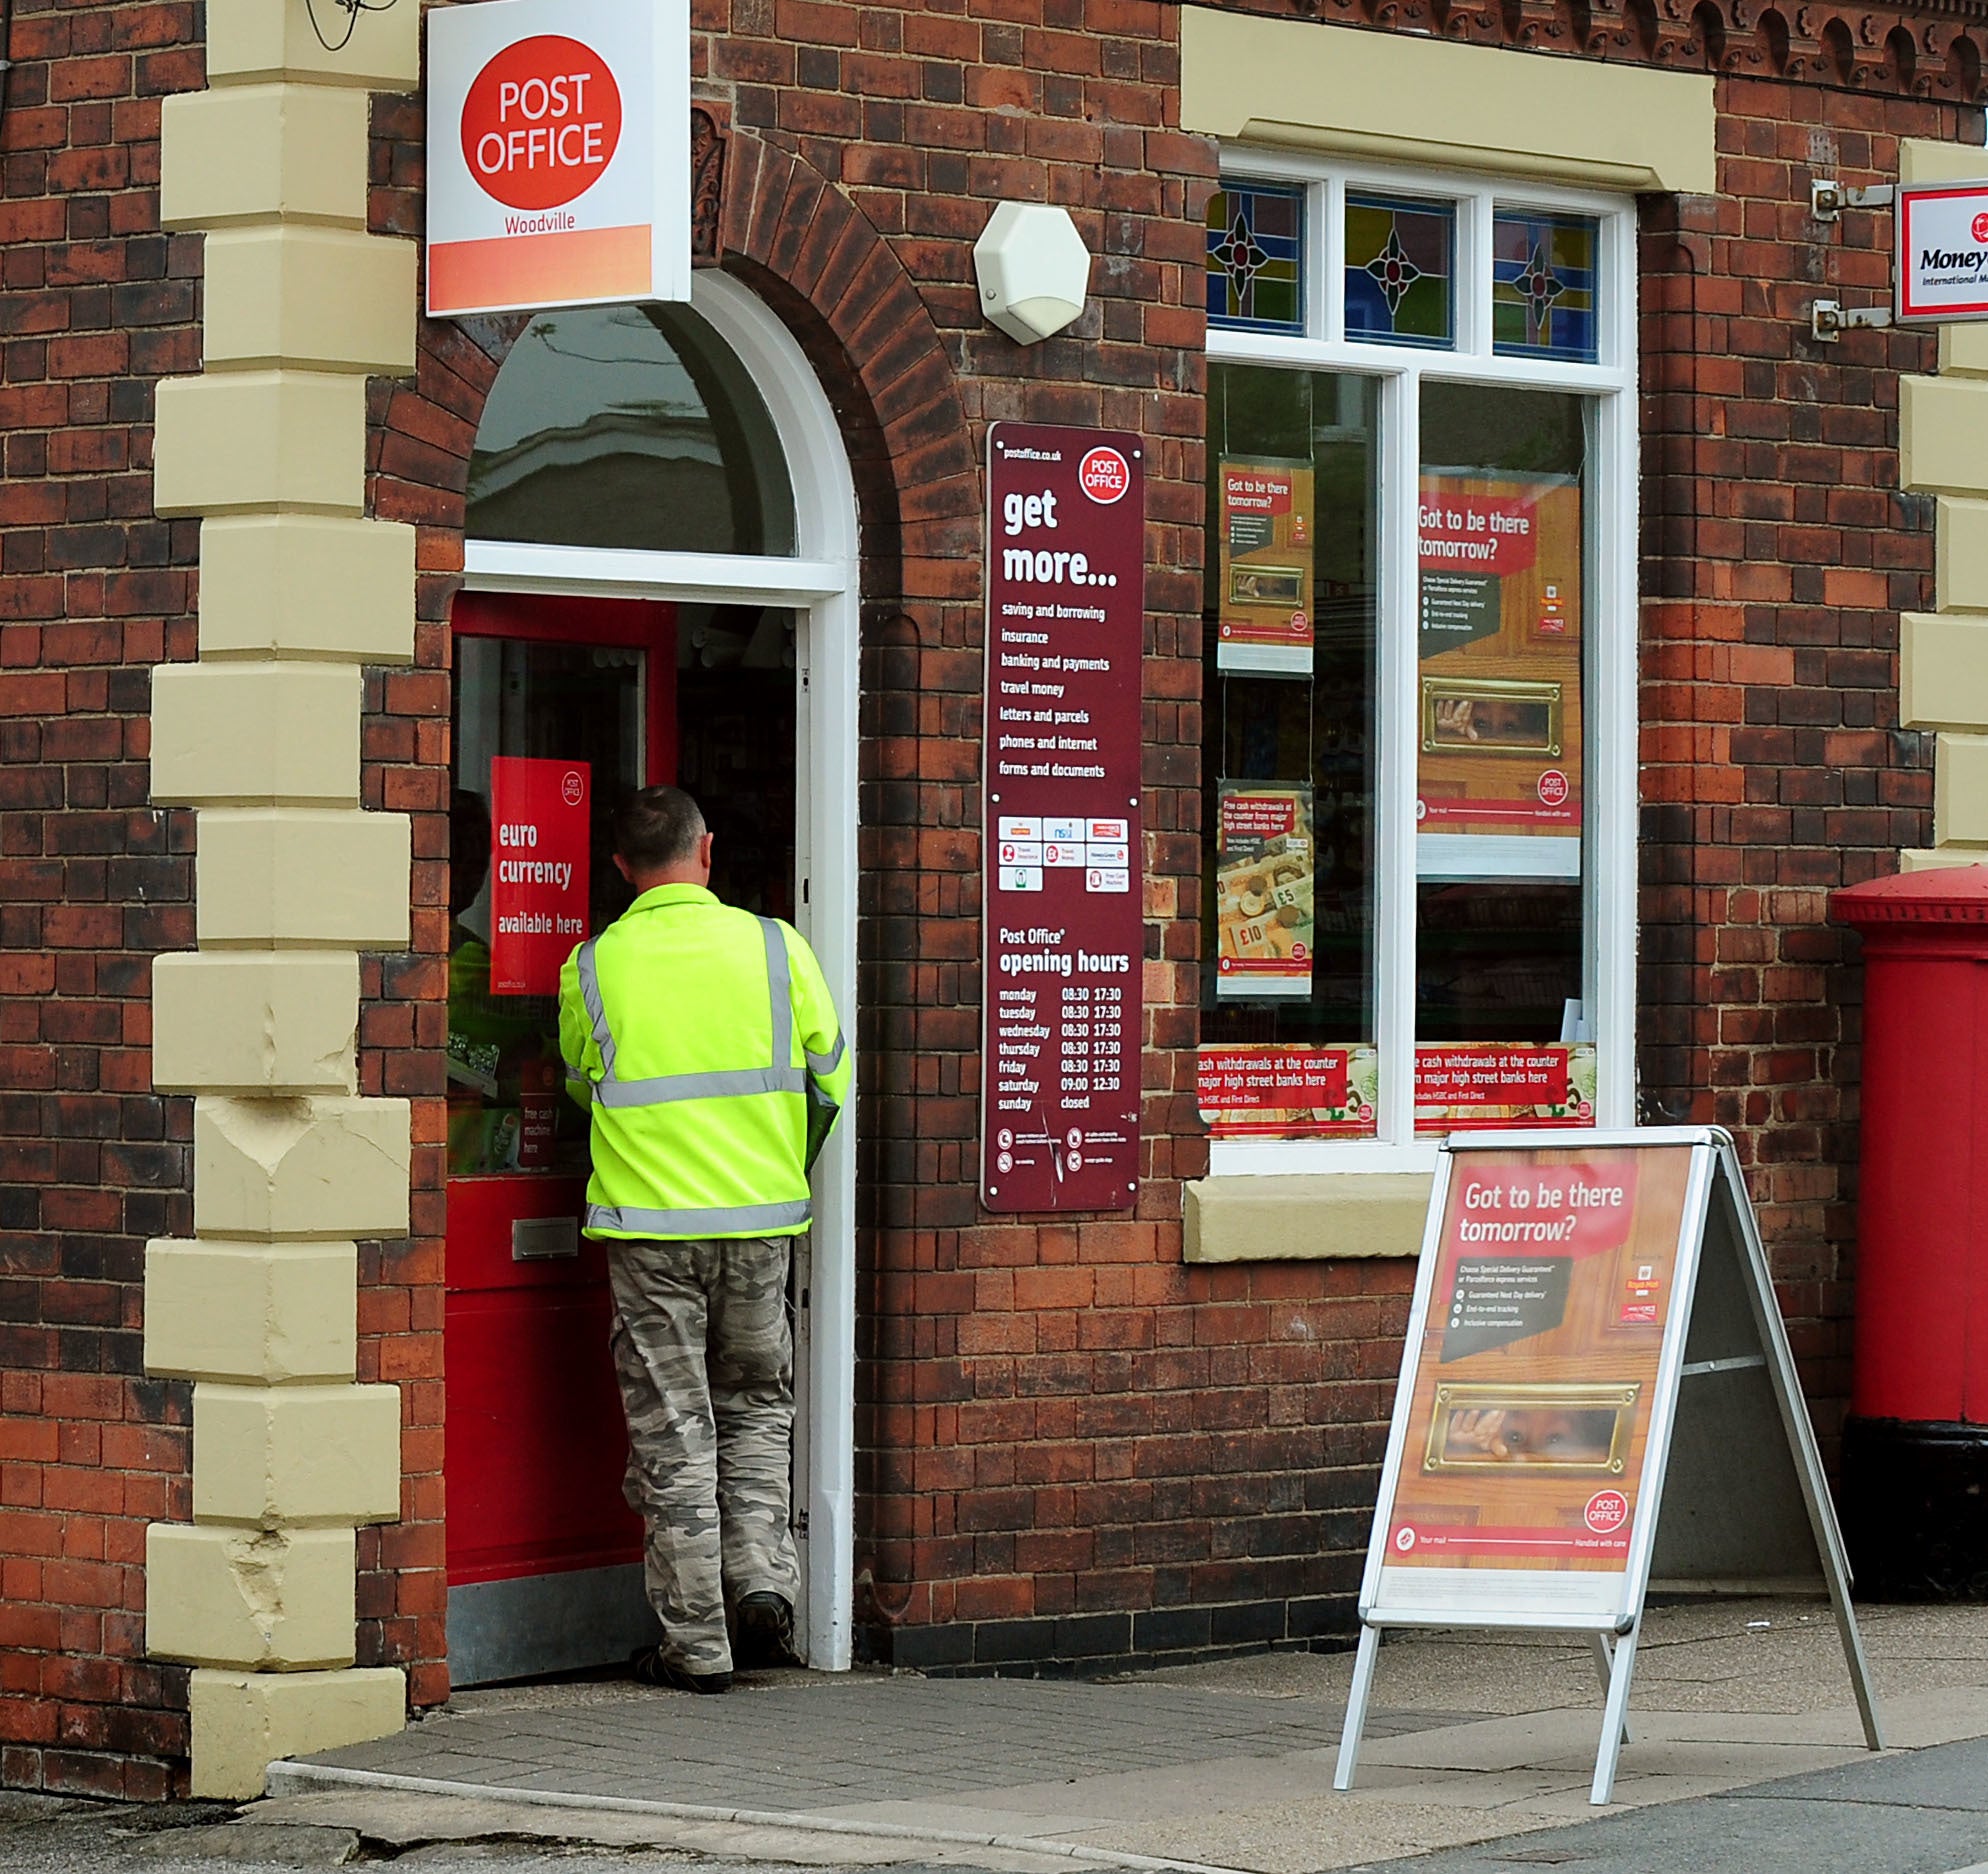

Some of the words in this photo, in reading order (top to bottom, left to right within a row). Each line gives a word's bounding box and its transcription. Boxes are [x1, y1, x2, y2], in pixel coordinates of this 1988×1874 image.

[499, 73, 592, 123] POST
[476, 122, 604, 175] OFFICE
[504, 212, 576, 235] Woodville
[1920, 249, 1988, 272] Money
[1922, 274, 1978, 287] International
[1003, 447, 1062, 462] postoffice.co.uk
[1091, 459, 1119, 474] POST
[1085, 475, 1123, 489] OFFICE
[1227, 478, 1243, 493] Got
[1244, 480, 1254, 494] to
[1255, 481, 1266, 494] be
[1268, 482, 1289, 496] there
[1227, 495, 1273, 509] tomorrow?
[1003, 489, 1058, 536] get
[1418, 504, 1443, 530] Got
[1446, 509, 1463, 531] to
[1466, 509, 1487, 532] be
[1489, 511, 1530, 535] there
[1418, 535, 1498, 561] tomorrow?
[1003, 548, 1117, 588] more...
[1001, 602, 1034, 619] saving
[1035, 603, 1055, 618] and
[1056, 604, 1106, 623] borrowing
[1001, 628, 1049, 644] insurance
[1000, 652, 1040, 671] banking
[1042, 655, 1061, 669] and
[1062, 658, 1110, 672] payments
[1000, 680, 1030, 694] travel
[1031, 685, 1065, 699] money
[1000, 706, 1032, 722] letters
[1033, 708, 1053, 722] and
[1054, 710, 1090, 725] parcels
[999, 734, 1035, 750] phones
[1037, 735, 1056, 749] and
[1057, 736, 1098, 751] internet
[999, 760, 1029, 775] forms
[1030, 762, 1050, 776] and
[1051, 763, 1105, 778] documents
[1544, 777, 1562, 787] POST
[1541, 787, 1564, 796] OFFICE
[499, 823, 538, 848] euro
[499, 859, 572, 892] currency
[1277, 889, 1295, 906] £5
[498, 911, 552, 934] available
[556, 912, 583, 935] here
[1000, 927, 1026, 944] Post
[1240, 925, 1262, 946] £10
[999, 947, 1073, 977] opening
[1077, 949, 1130, 973] hours
[999, 988, 1037, 1003] monday
[1062, 987, 1090, 1001] 08:30
[1094, 987, 1122, 1001] 17:30
[999, 1006, 1036, 1021] tuesday
[1062, 1005, 1090, 1019] 08:30
[1094, 1005, 1122, 1019] 17:30
[998, 1024, 1051, 1040] wednesday
[1061, 1023, 1089, 1037] 08:30
[1093, 1023, 1121, 1037] 17:30
[998, 1042, 1041, 1057] thursday
[1061, 1041, 1089, 1055] 08:30
[1093, 1041, 1121, 1055] 17:30
[998, 1060, 1027, 1076] friday
[1061, 1059, 1089, 1073] 08:30
[1093, 1059, 1121, 1073] 17:30
[1197, 1056, 1214, 1071] ash
[1216, 1057, 1272, 1070] withdrawals
[1273, 1058, 1285, 1070] at
[1286, 1057, 1301, 1070] the
[1303, 1058, 1338, 1070] counter
[1422, 1055, 1442, 1068] cash
[1444, 1054, 1497, 1068] withdrawals
[1498, 1056, 1509, 1067] at
[1510, 1055, 1525, 1067] the
[1526, 1055, 1559, 1067] counter
[998, 1078, 1040, 1094] saturday
[1061, 1077, 1089, 1091] 09:00
[1093, 1077, 1121, 1091] 12:30
[1224, 1073, 1244, 1090] high
[1246, 1074, 1274, 1087] street
[1276, 1073, 1303, 1087] banks
[1305, 1073, 1326, 1087] here
[1424, 1071, 1450, 1087] major
[1451, 1071, 1469, 1087] high
[1472, 1072, 1499, 1084] street
[1500, 1071, 1526, 1084] banks
[1528, 1071, 1548, 1084] here
[998, 1096, 1032, 1112] sunday
[1061, 1096, 1090, 1109] closed
[1465, 1182, 1503, 1210] Got
[1508, 1184, 1531, 1210] to
[1536, 1182, 1563, 1209] be
[1568, 1181, 1623, 1208] there
[1459, 1214, 1577, 1243] tomorrow?
[1595, 1499, 1621, 1511] POST
[1588, 1510, 1622, 1522] OFFICE
[1419, 1536, 1433, 1545] Your
